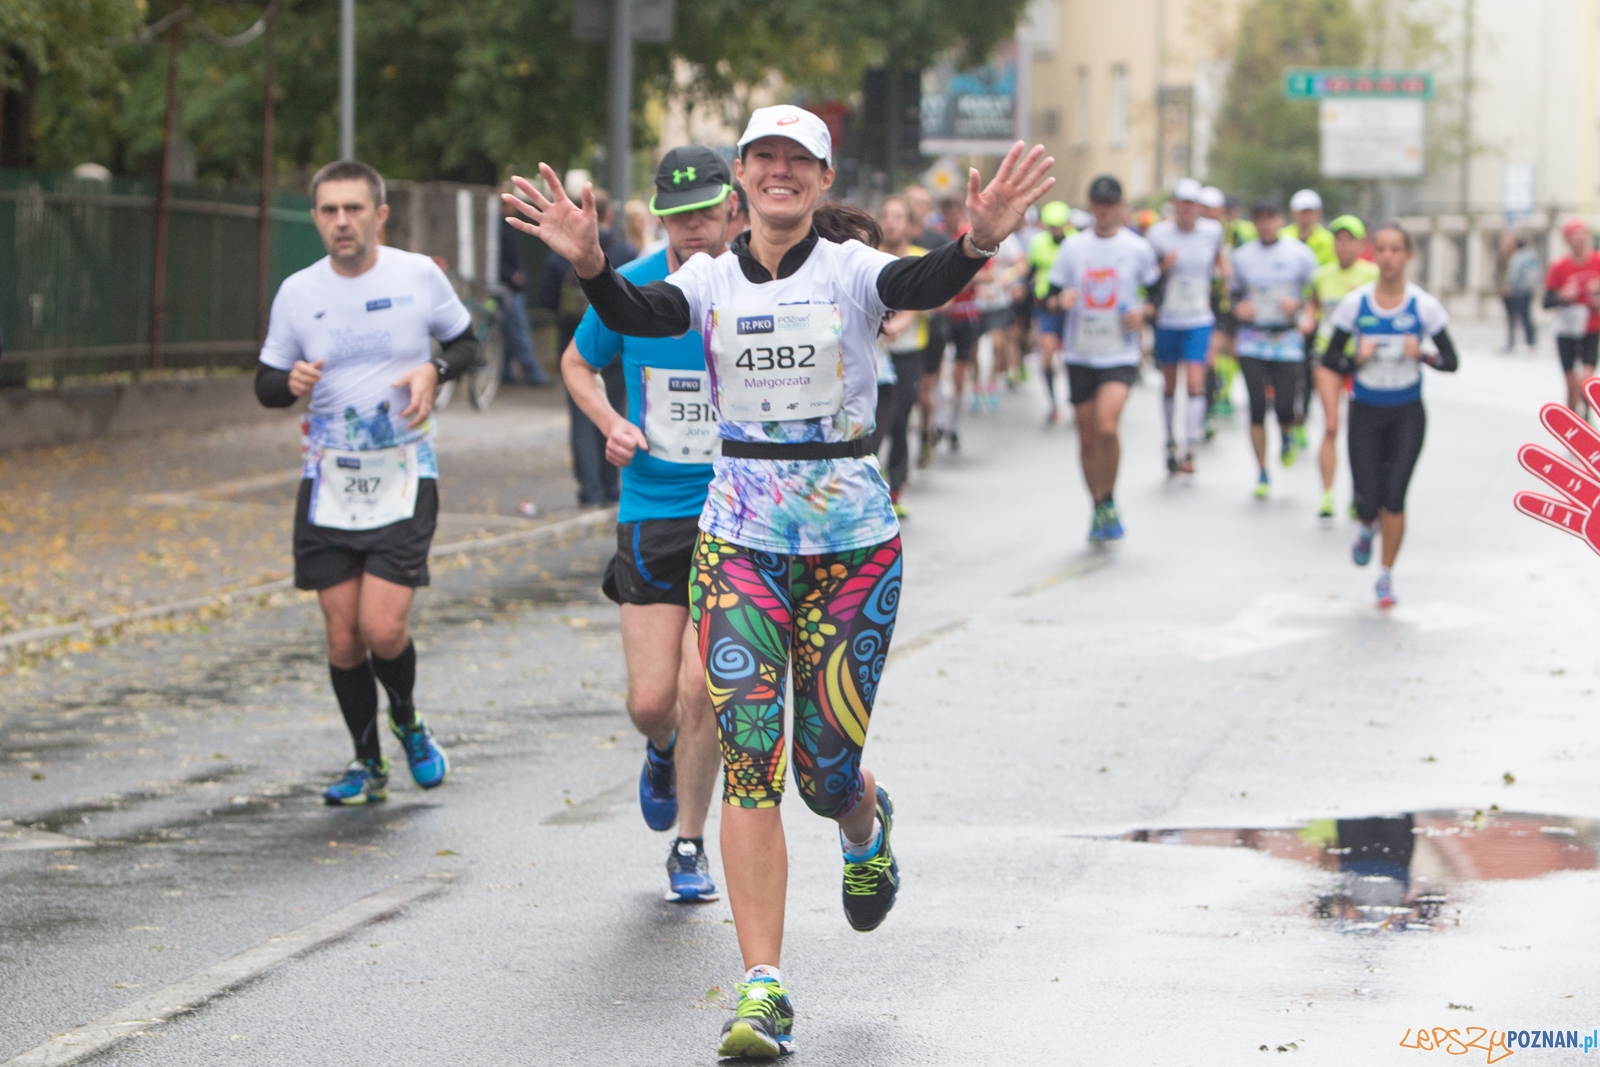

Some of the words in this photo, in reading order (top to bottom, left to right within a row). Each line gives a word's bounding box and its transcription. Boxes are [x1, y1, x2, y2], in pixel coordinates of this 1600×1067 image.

[740, 319, 772, 331] 17.PKO
[735, 344, 815, 371] 4382
[744, 376, 811, 389] Małgorzata
[686, 427, 709, 436] John
[344, 477, 381, 493] 287
